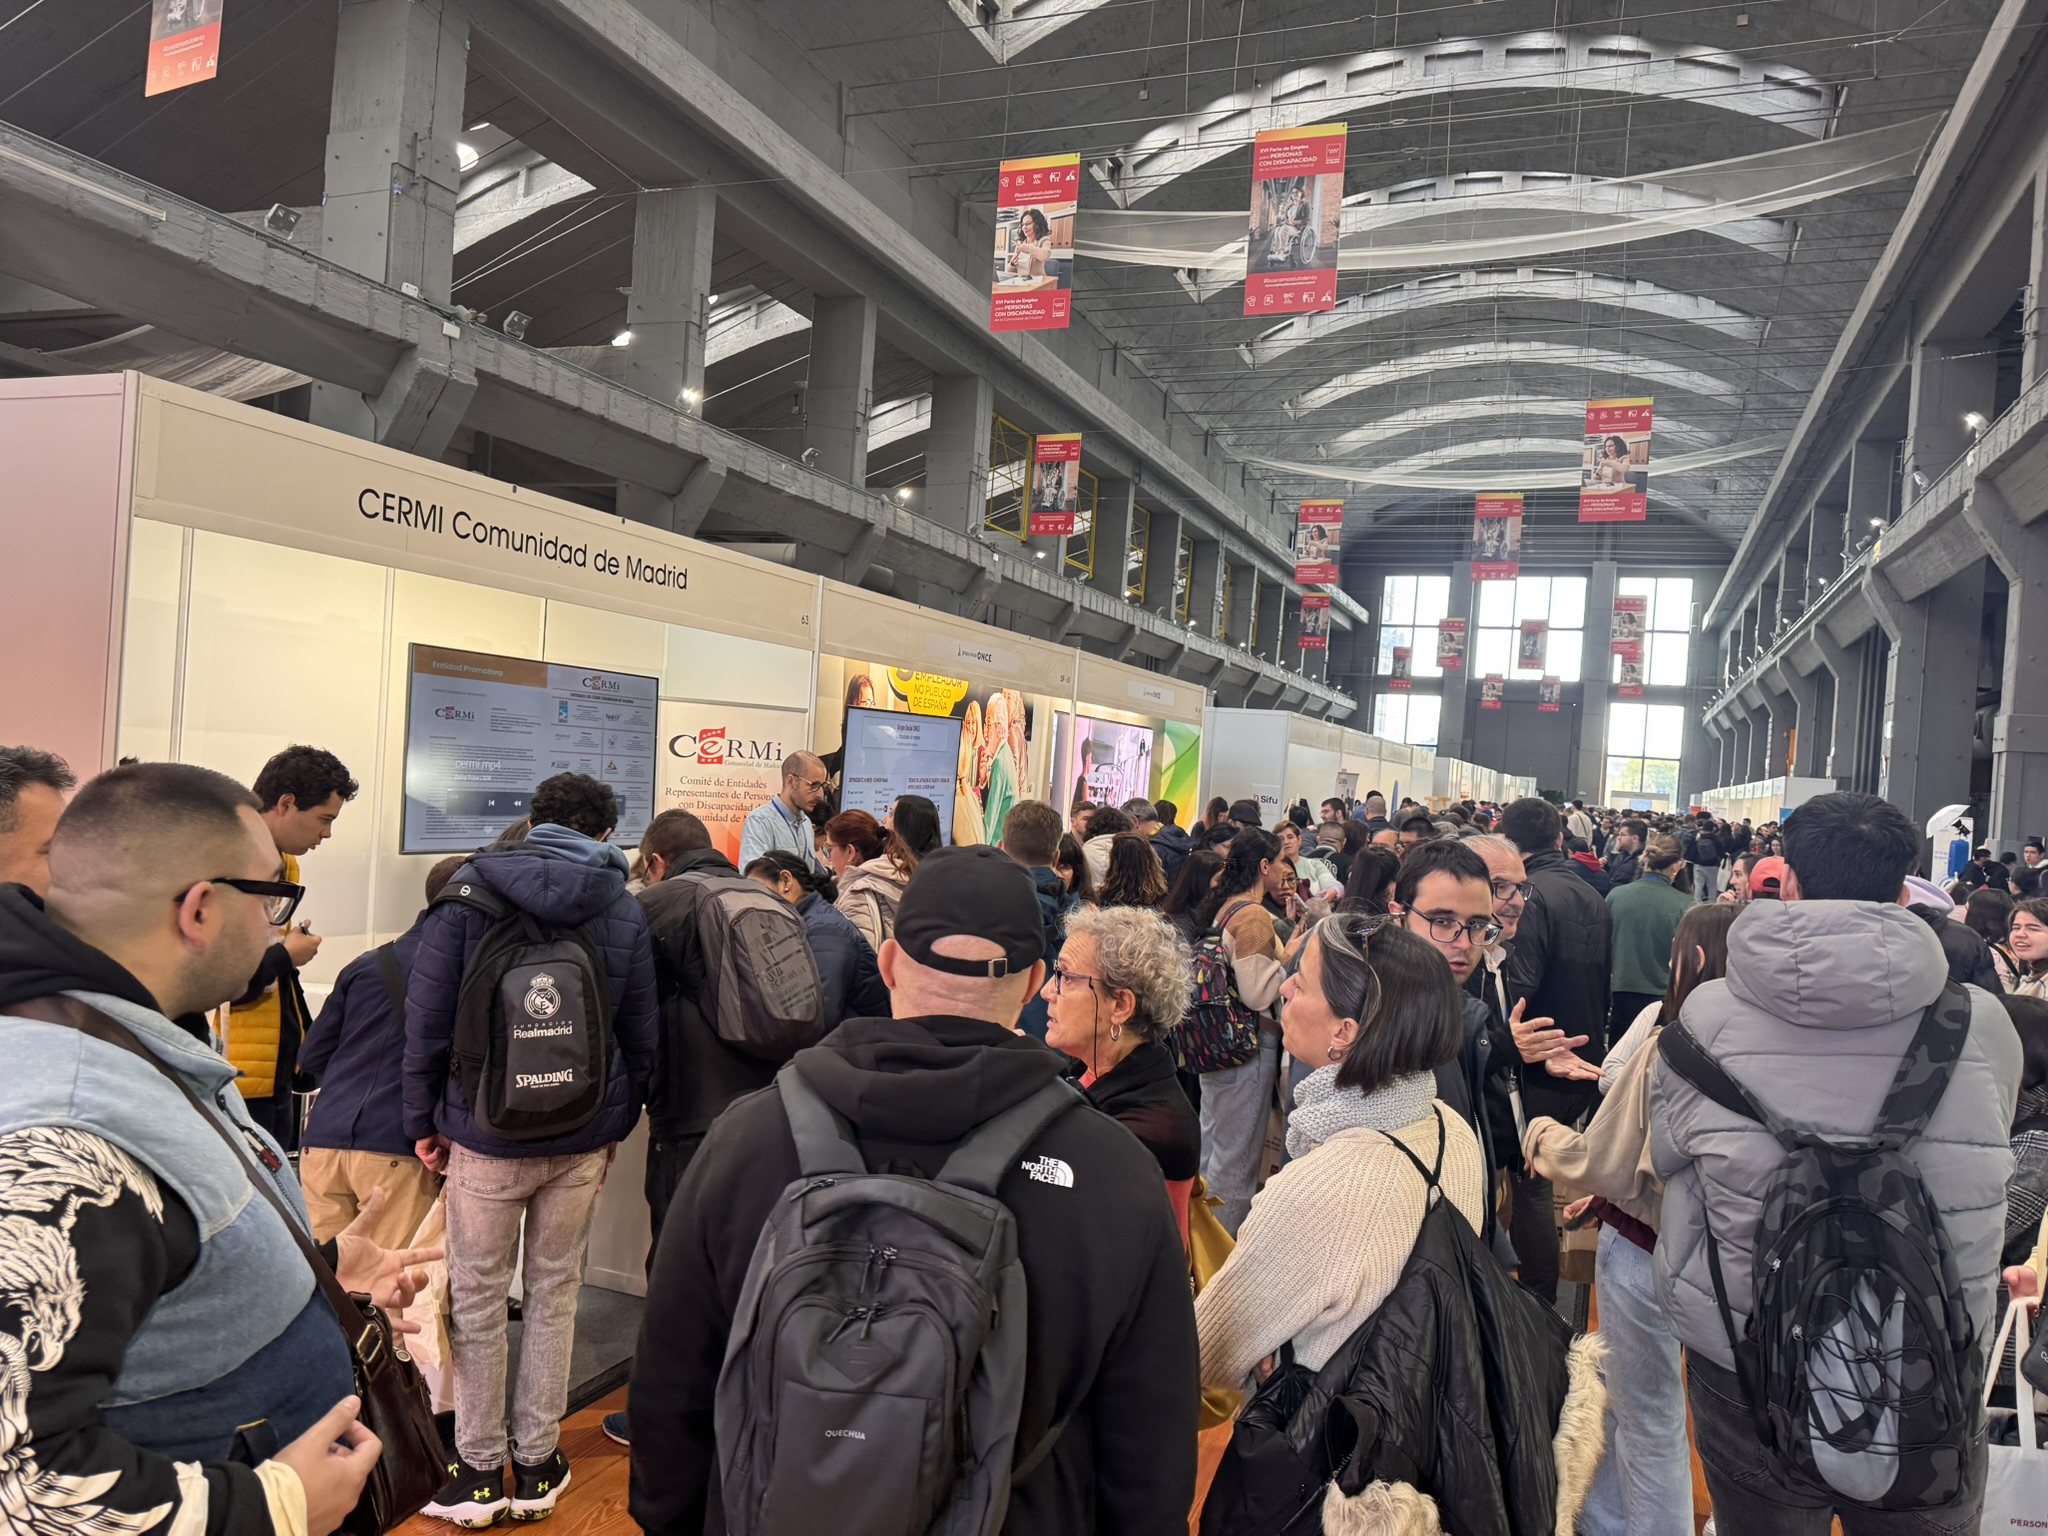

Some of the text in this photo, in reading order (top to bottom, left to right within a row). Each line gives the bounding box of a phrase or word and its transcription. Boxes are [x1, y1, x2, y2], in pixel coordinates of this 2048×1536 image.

[1270, 151, 1302, 159] PERSONAS
[1273, 156, 1317, 165] DISCAPACIDAD
[1007, 309, 1045, 317] DISCAPACIDAD
[358, 488, 688, 590] CERMI Comunidad de Madrid
[801, 614, 809, 625] 63
[977, 651, 992, 663] ONCE
[432, 660, 504, 676] Entidad Promotora
[915, 672, 962, 688] EMPLEADOR
[913, 684, 924, 695] NO
[913, 697, 948, 711] DE ESPAÑA
[724, 759, 754, 767] Comunidad
[680, 775, 767, 789] Comité de Entidades
[665, 787, 729, 798] Representantes
[731, 790, 741, 799] de
[696, 800, 753, 812] Discapacidad
[1260, 795, 1278, 805] Sifu
[730, 814, 741, 822] de
[513, 1025, 573, 1039] Realmadrid
[515, 1068, 573, 1088] SPALDING
[1039, 1155, 1059, 1168] THE
[1021, 1161, 1057, 1176] NORTH
[1030, 1171, 1056, 1184] FACE
[825, 1430, 866, 1440] QUECHUA
